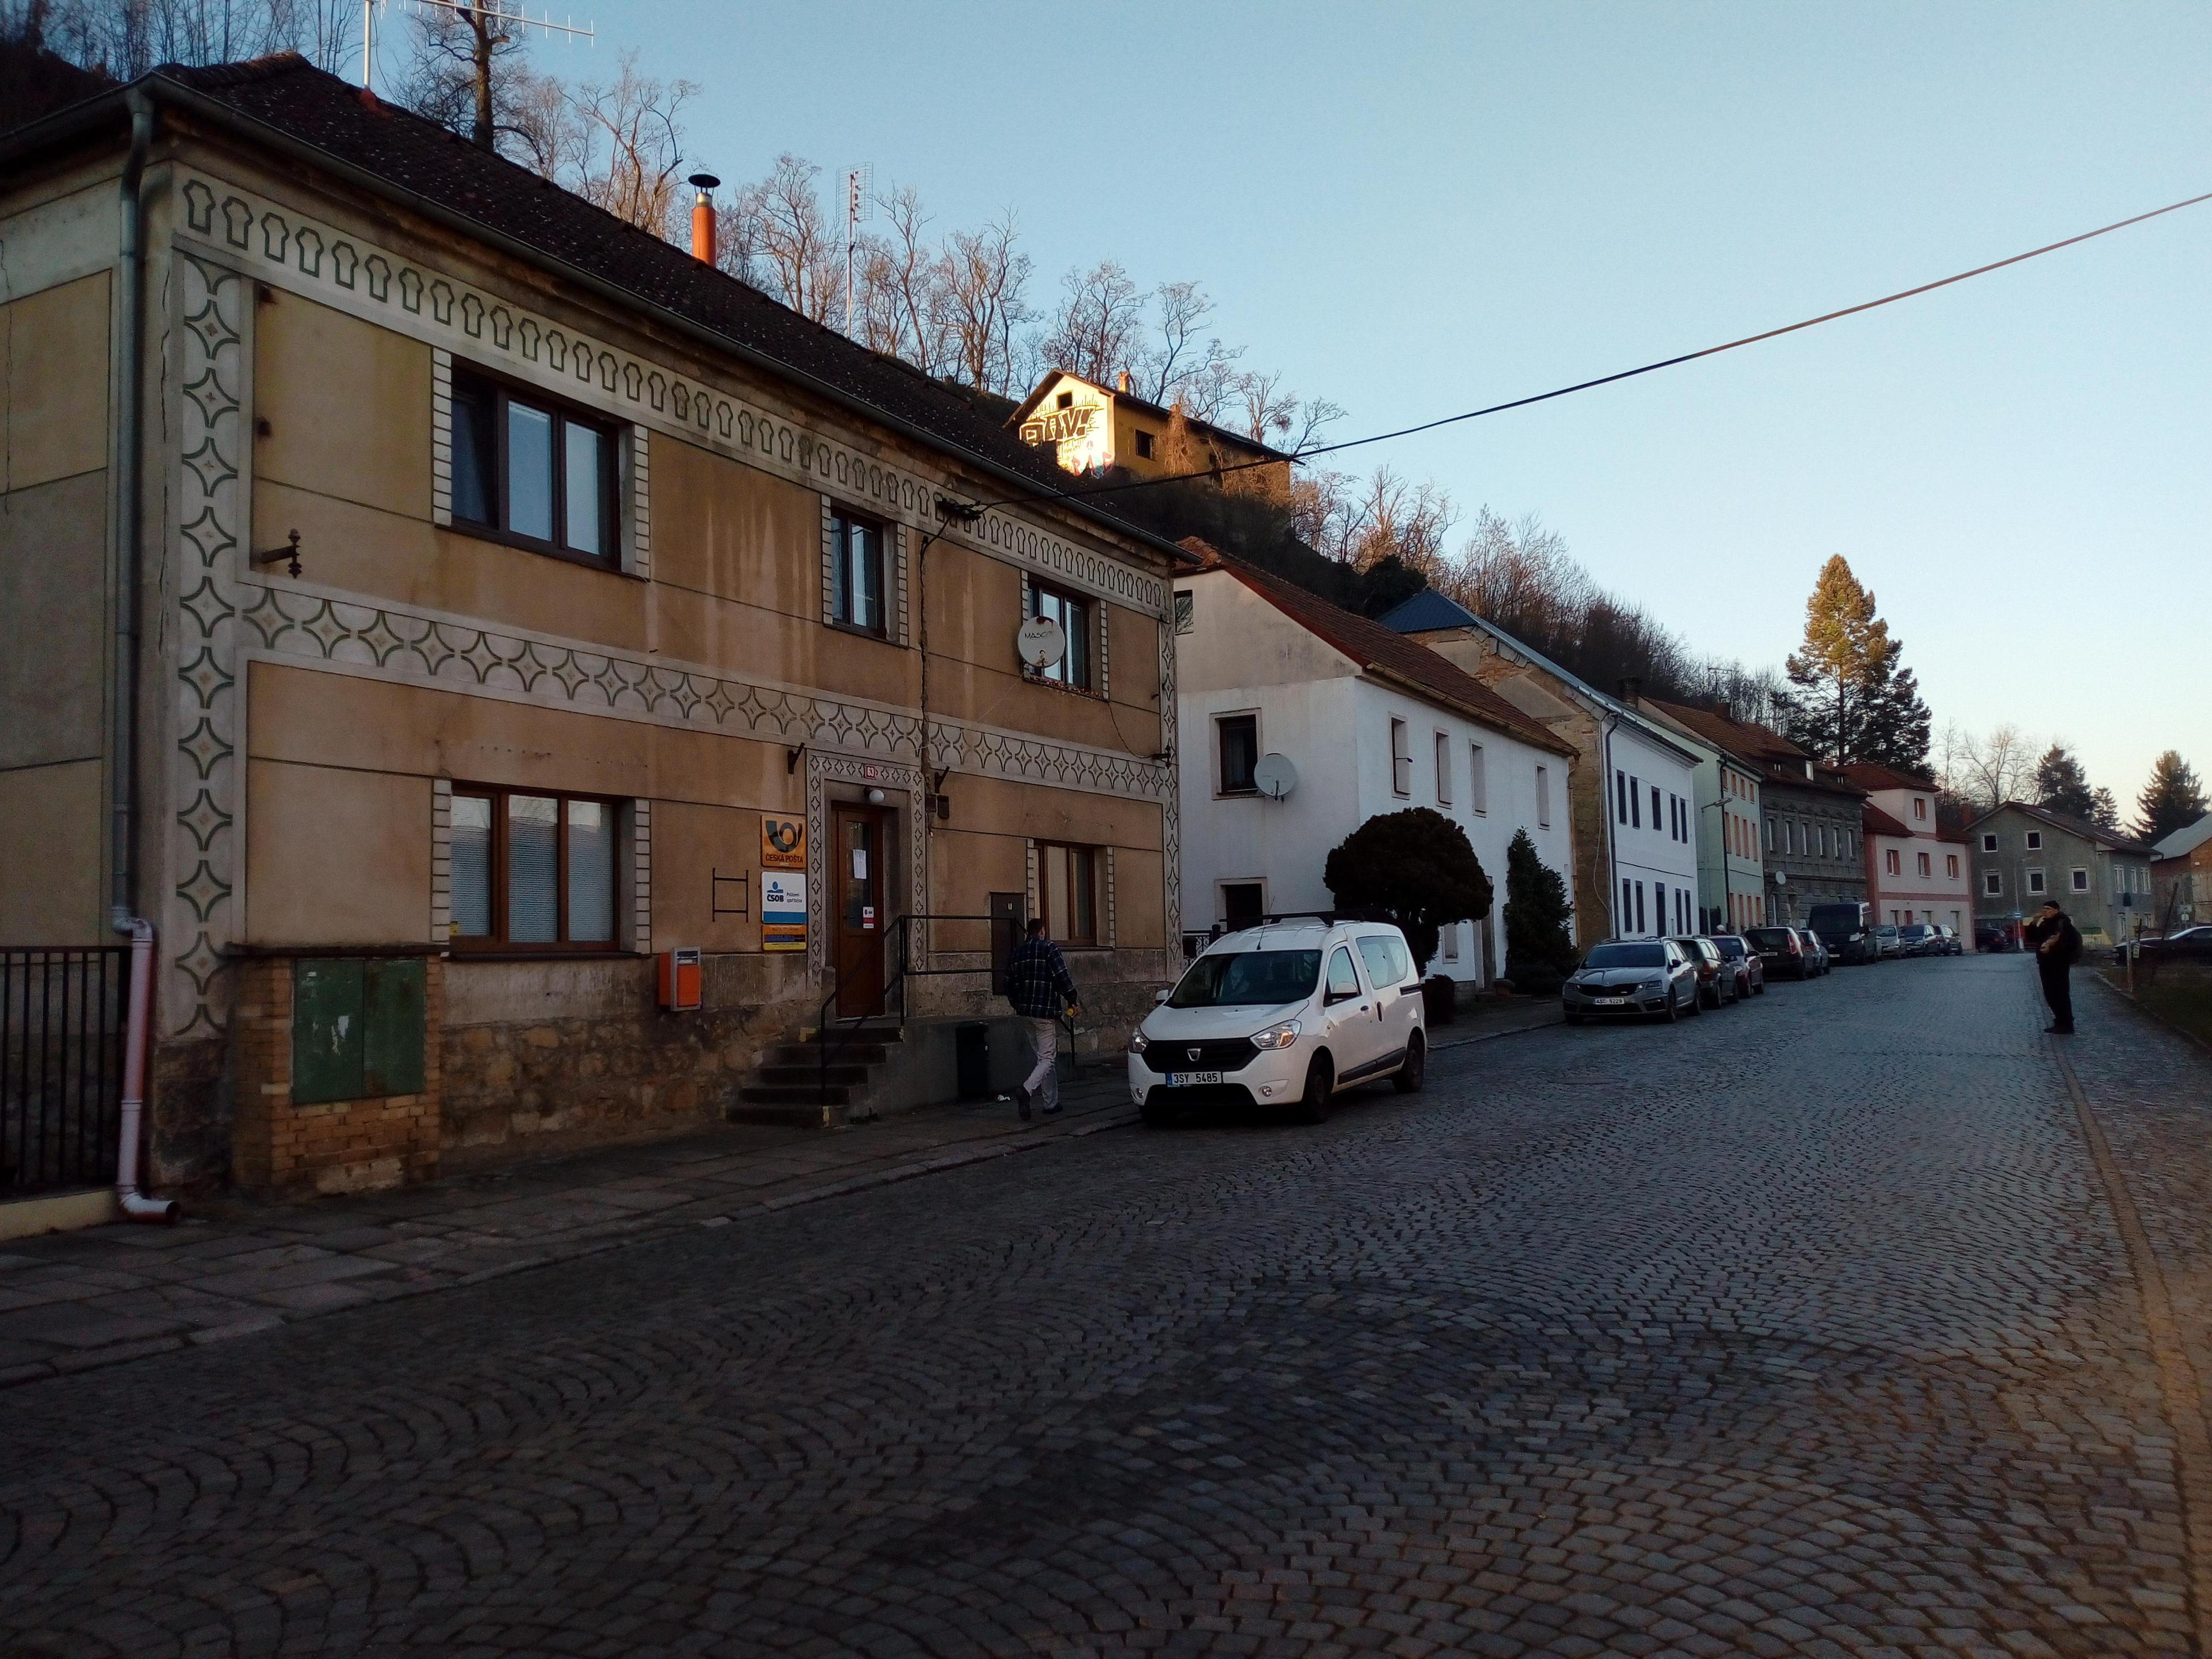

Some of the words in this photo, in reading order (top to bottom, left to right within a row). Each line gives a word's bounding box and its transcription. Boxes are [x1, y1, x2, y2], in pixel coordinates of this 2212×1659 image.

[867, 766, 874, 777] 63
[765, 852, 785, 862] ČESKÁ
[785, 854, 804, 863] POŠTA
[767, 893, 784, 902] ČSOB
[1173, 1073, 1190, 1083] 3SY
[1196, 1072, 1218, 1083] 5485
